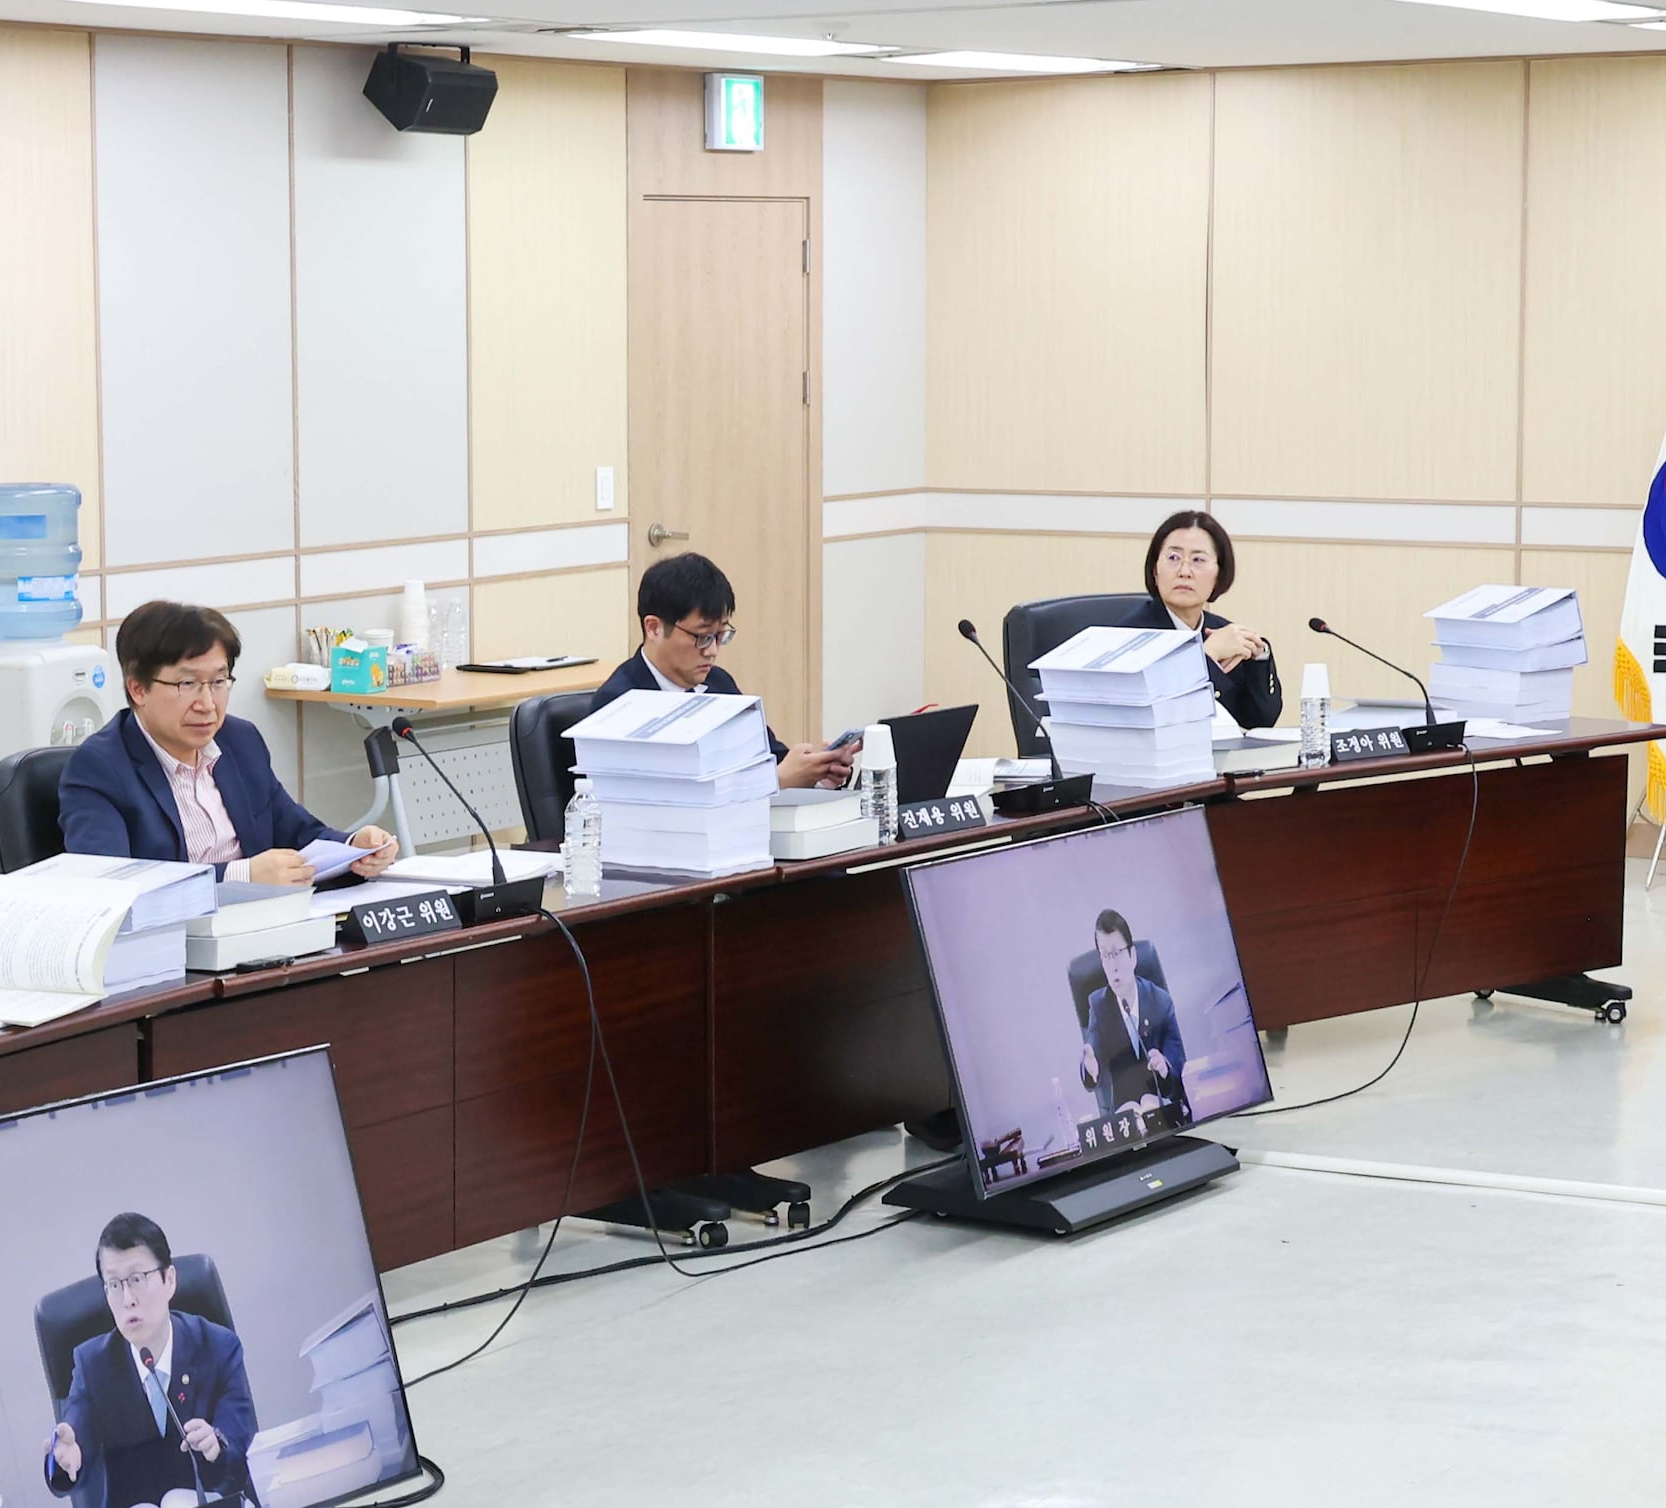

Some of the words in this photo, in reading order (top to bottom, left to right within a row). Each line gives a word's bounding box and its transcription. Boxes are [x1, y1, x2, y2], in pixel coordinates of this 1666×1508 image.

[1335, 734, 1374, 754] 조정아
[1377, 731, 1404, 750] 위원
[949, 799, 980, 822] 위원
[362, 905, 416, 935] 이강근
[418, 897, 454, 925] 위원
[1085, 1116, 1130, 1149] 위원장
